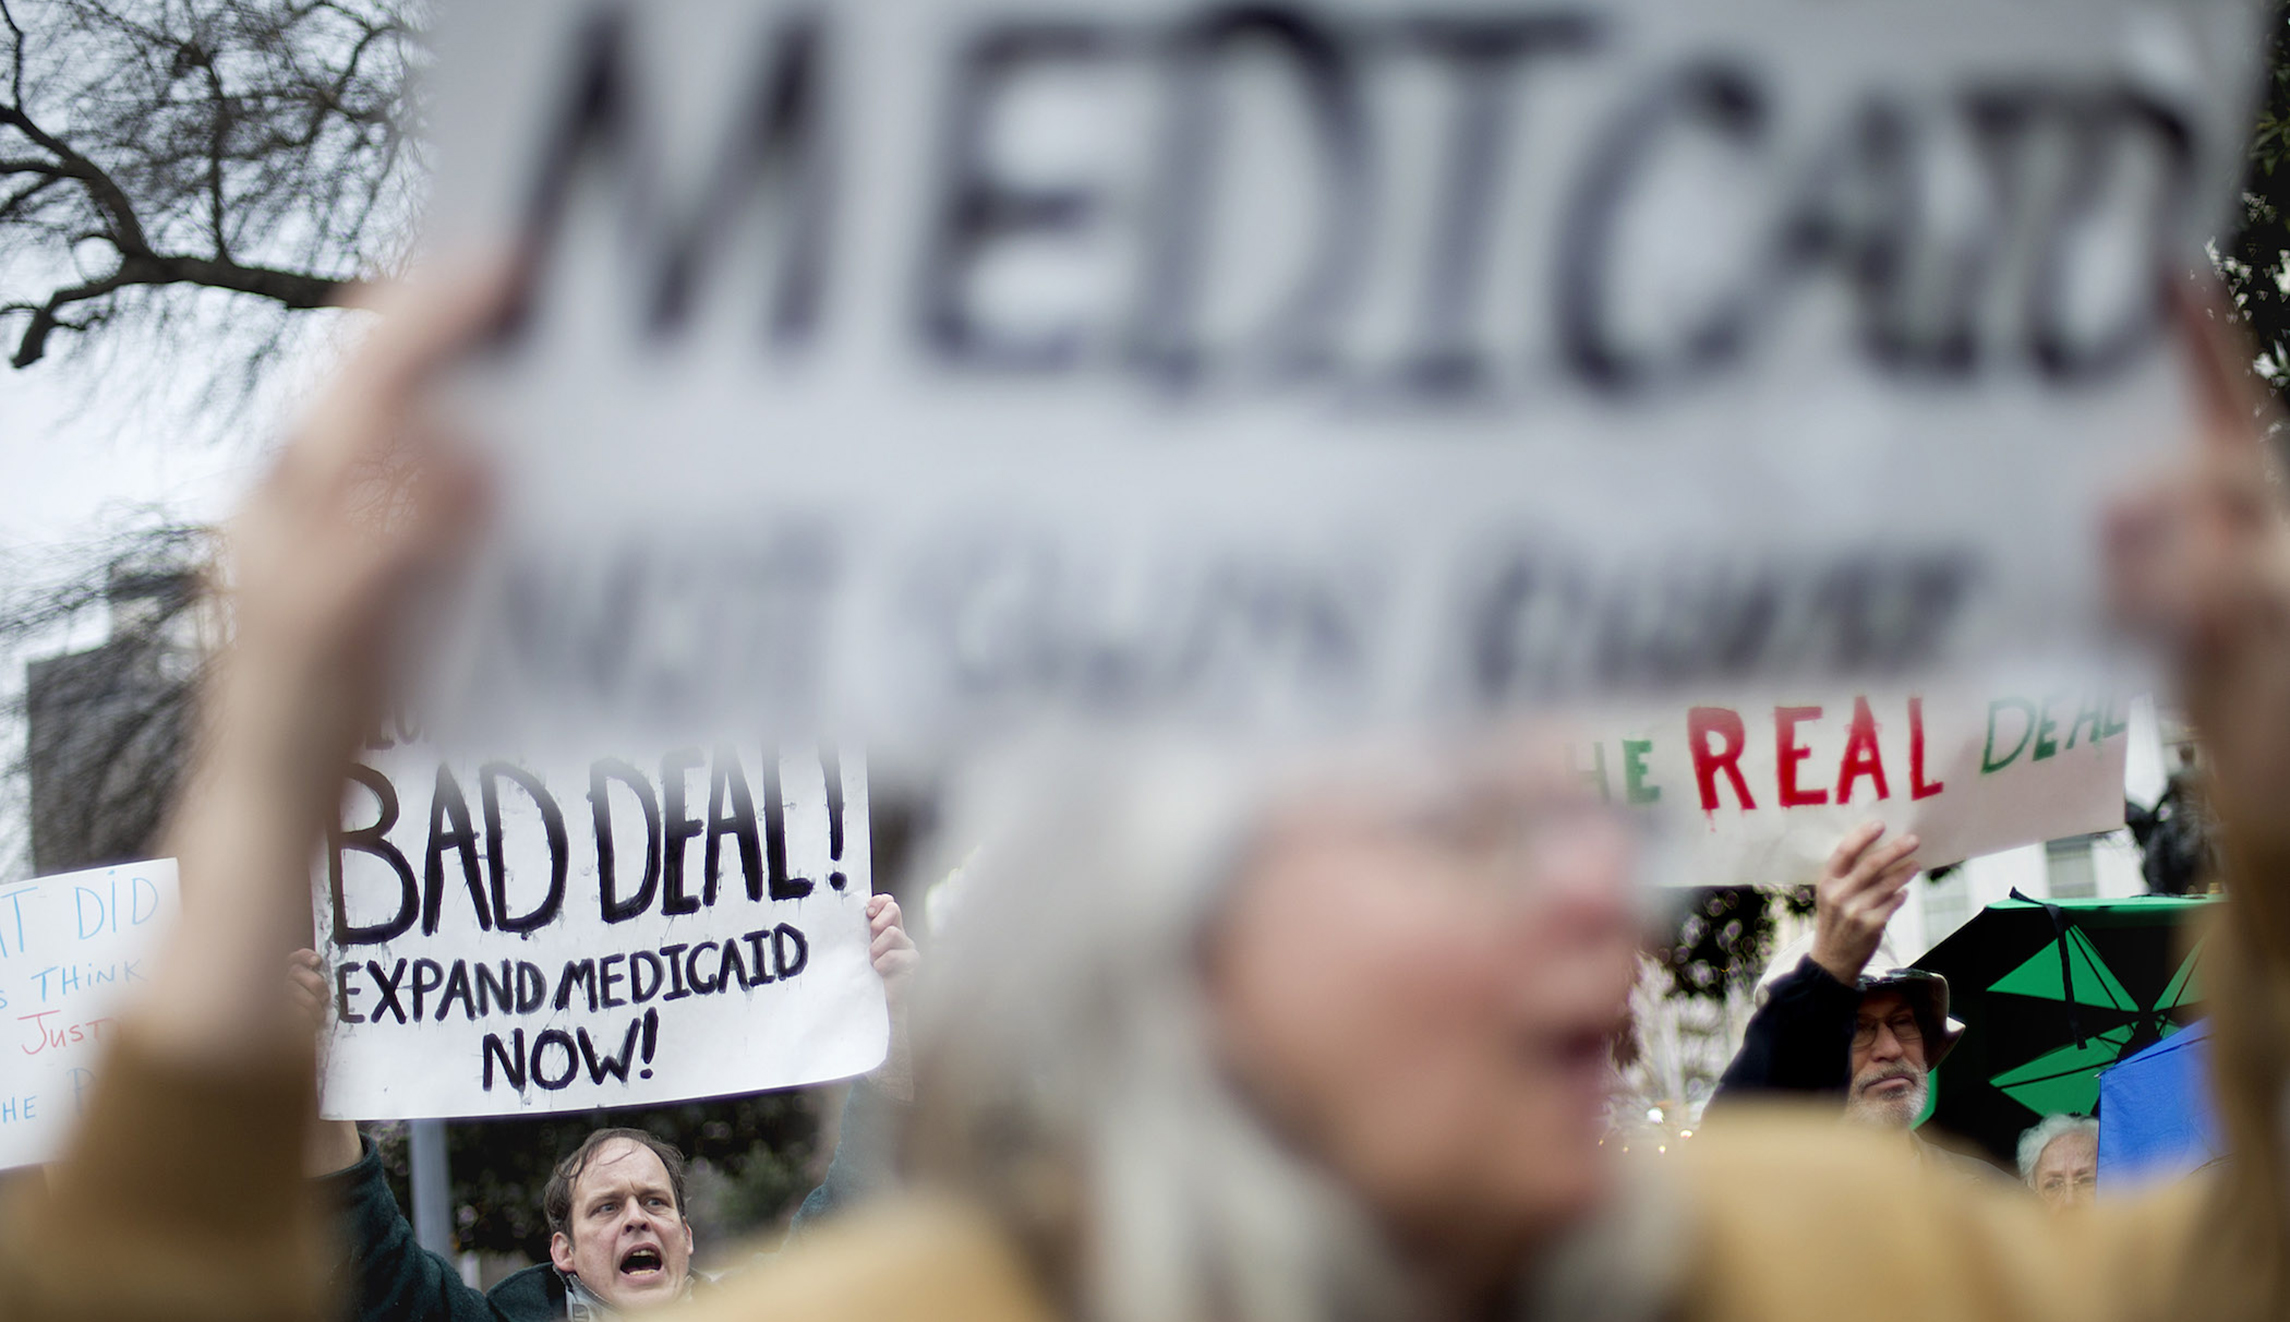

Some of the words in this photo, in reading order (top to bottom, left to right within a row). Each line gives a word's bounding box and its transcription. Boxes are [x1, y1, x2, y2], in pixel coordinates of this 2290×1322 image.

[492, 0, 2205, 405] MEDICAID
[1562, 738, 1662, 805] HE
[1687, 695, 1944, 811] REAL
[1981, 690, 2127, 774] DEAL
[327, 759, 569, 946] BAD
[588, 738, 848, 925] DEAL!
[0, 885, 39, 958] T
[337, 957, 547, 1025] EXPAND
[554, 922, 809, 1013] MEDICAID
[482, 1007, 659, 1092] NOW!
[1, 1094, 37, 1124] HE
